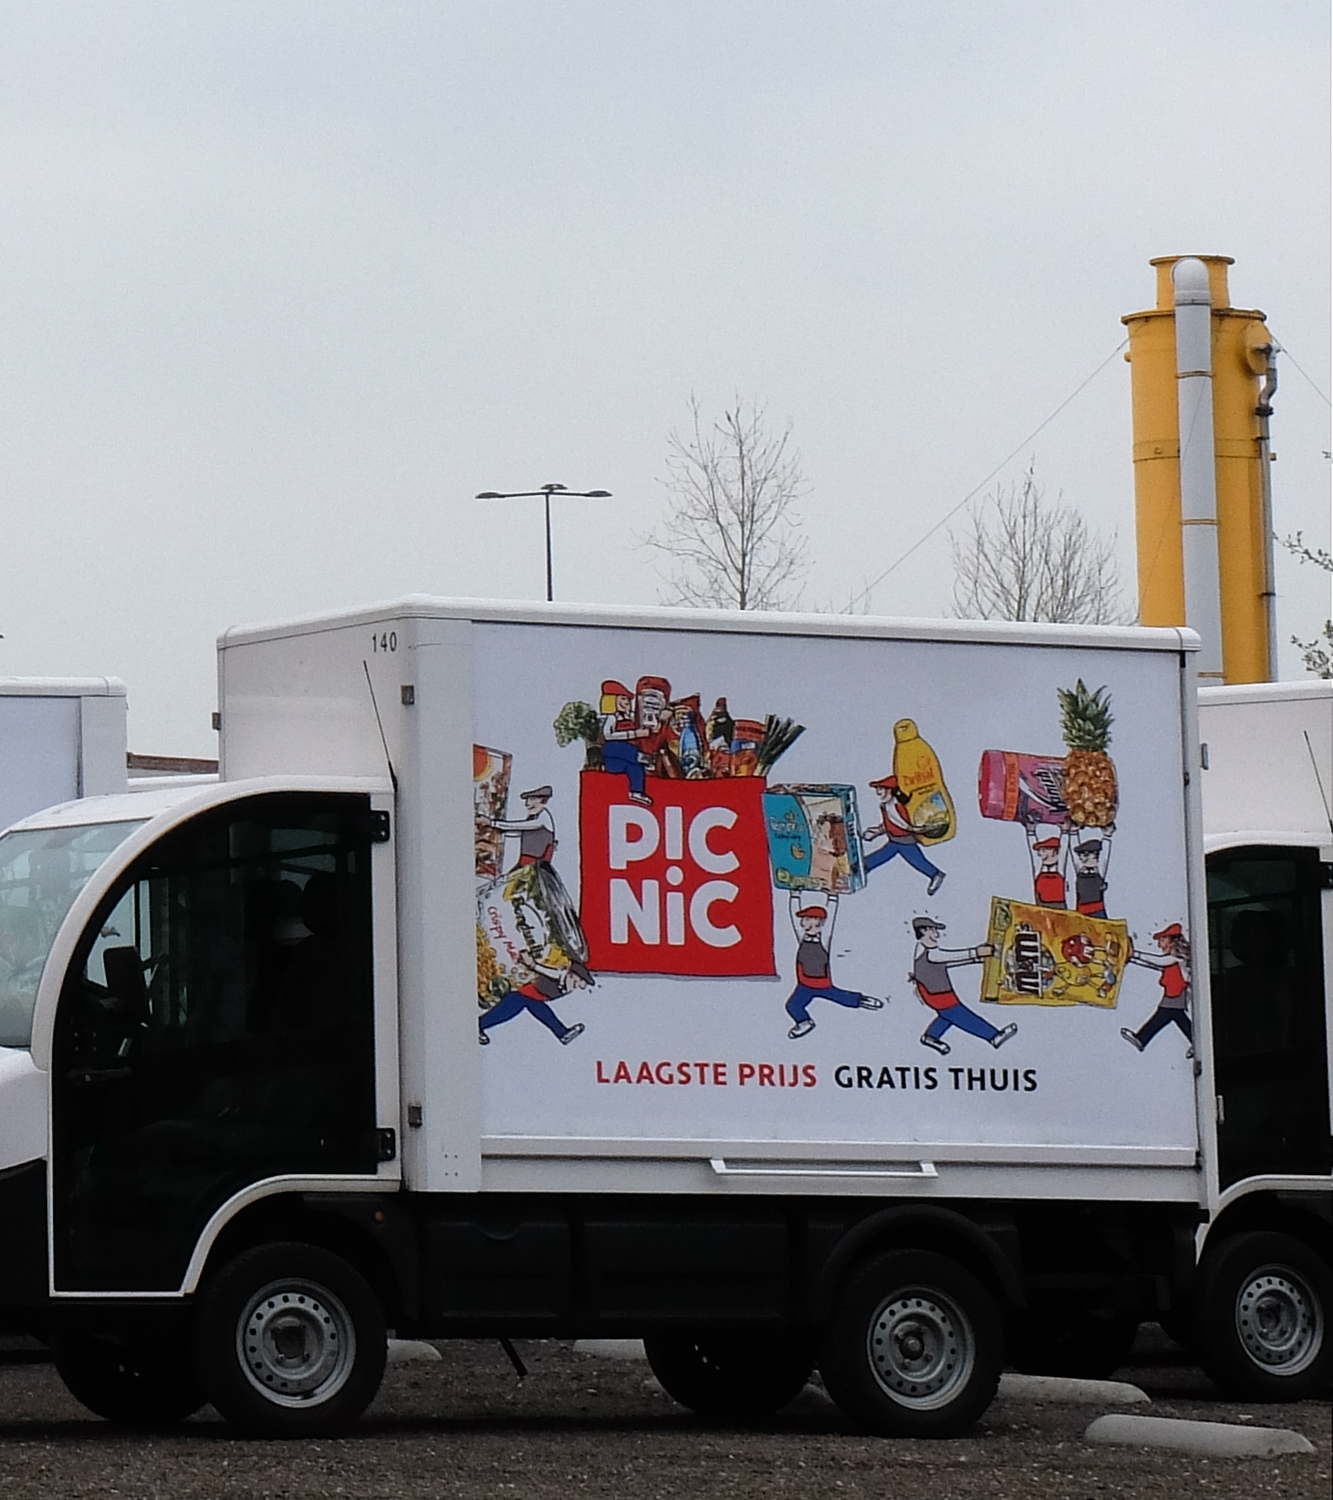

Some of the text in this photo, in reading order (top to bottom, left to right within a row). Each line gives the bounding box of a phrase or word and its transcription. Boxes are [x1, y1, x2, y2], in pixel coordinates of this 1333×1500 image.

[371, 631, 398, 652] 140
[595, 1060, 1039, 1092] LAAGSTE PRIJS GRATIS THUIS
